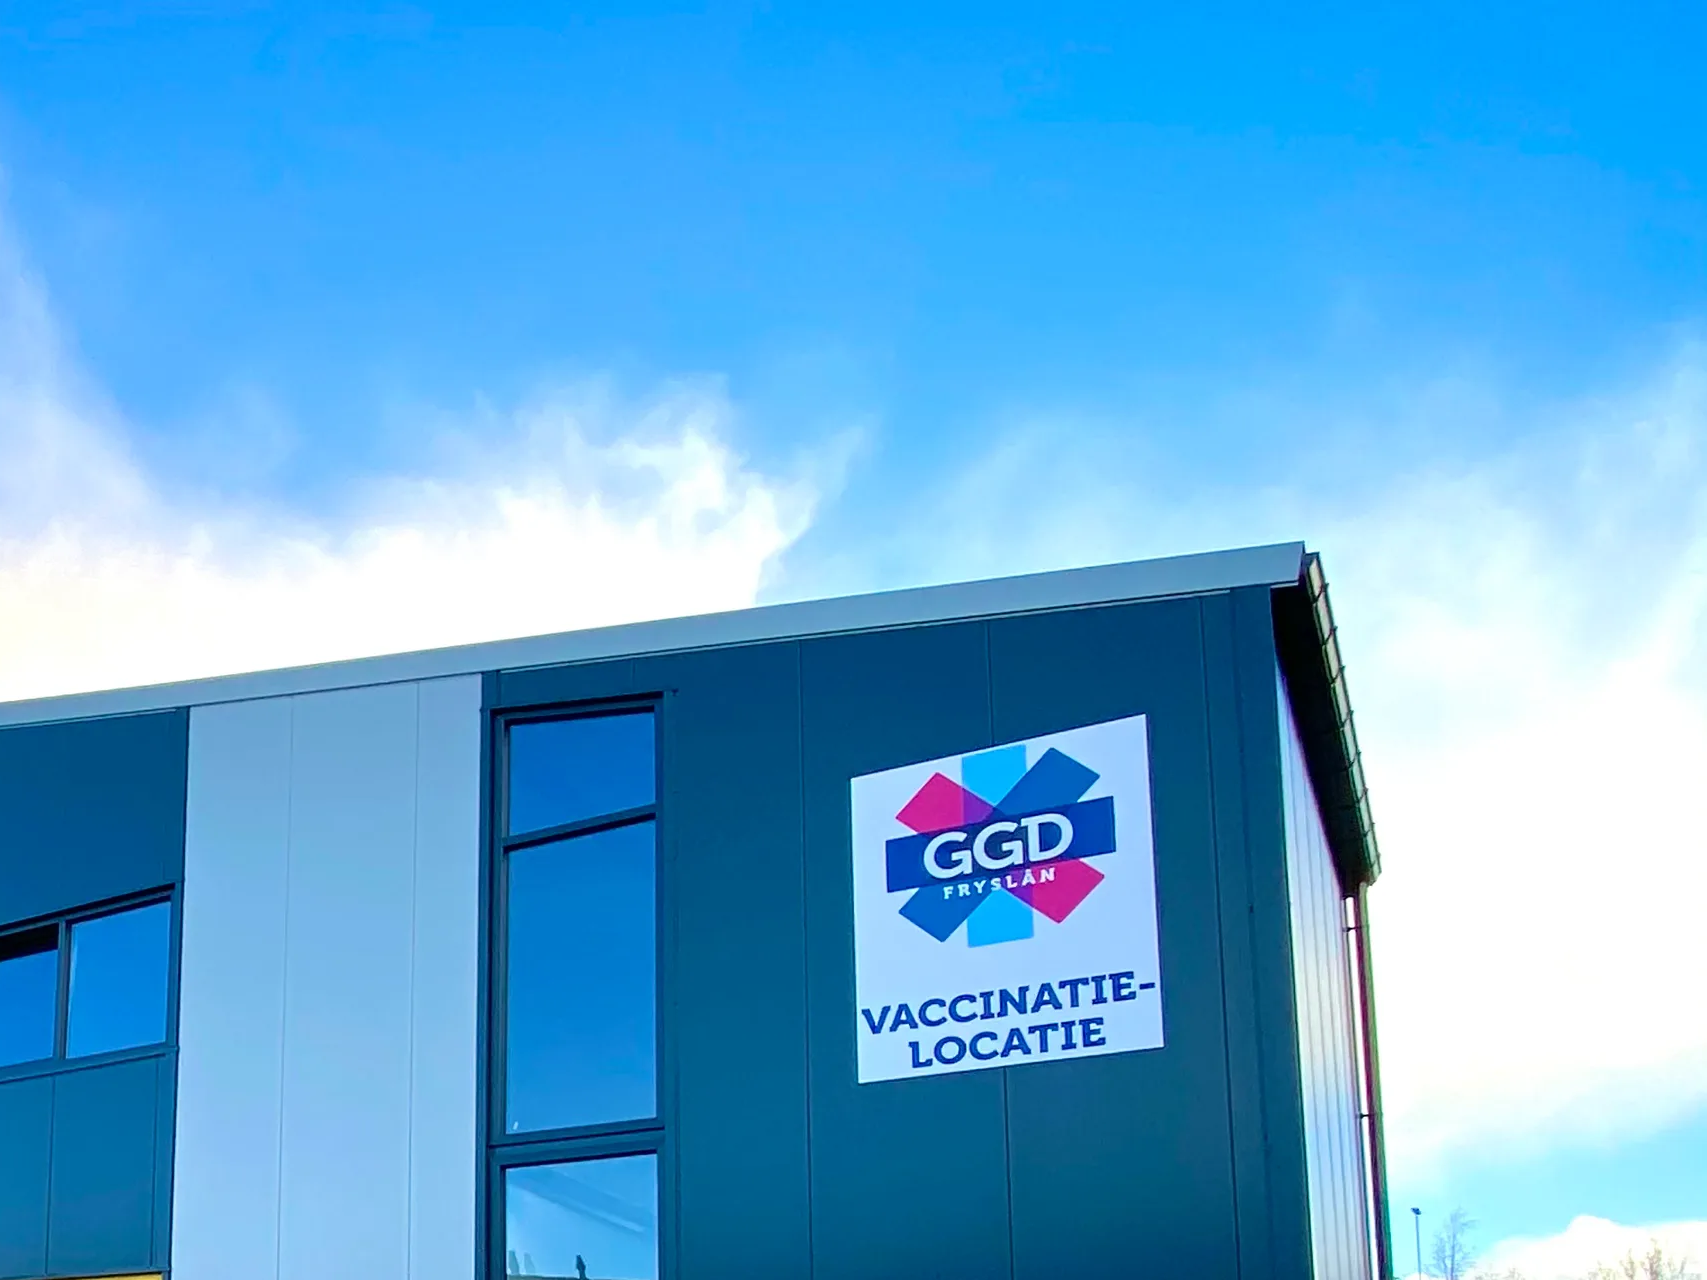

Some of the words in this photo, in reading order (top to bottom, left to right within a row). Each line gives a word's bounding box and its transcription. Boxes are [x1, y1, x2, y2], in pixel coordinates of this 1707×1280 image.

[922, 812, 1074, 881] GGD
[861, 970, 1156, 1035] VACCINATIE-
[908, 1017, 1107, 1069] LOCATIE
